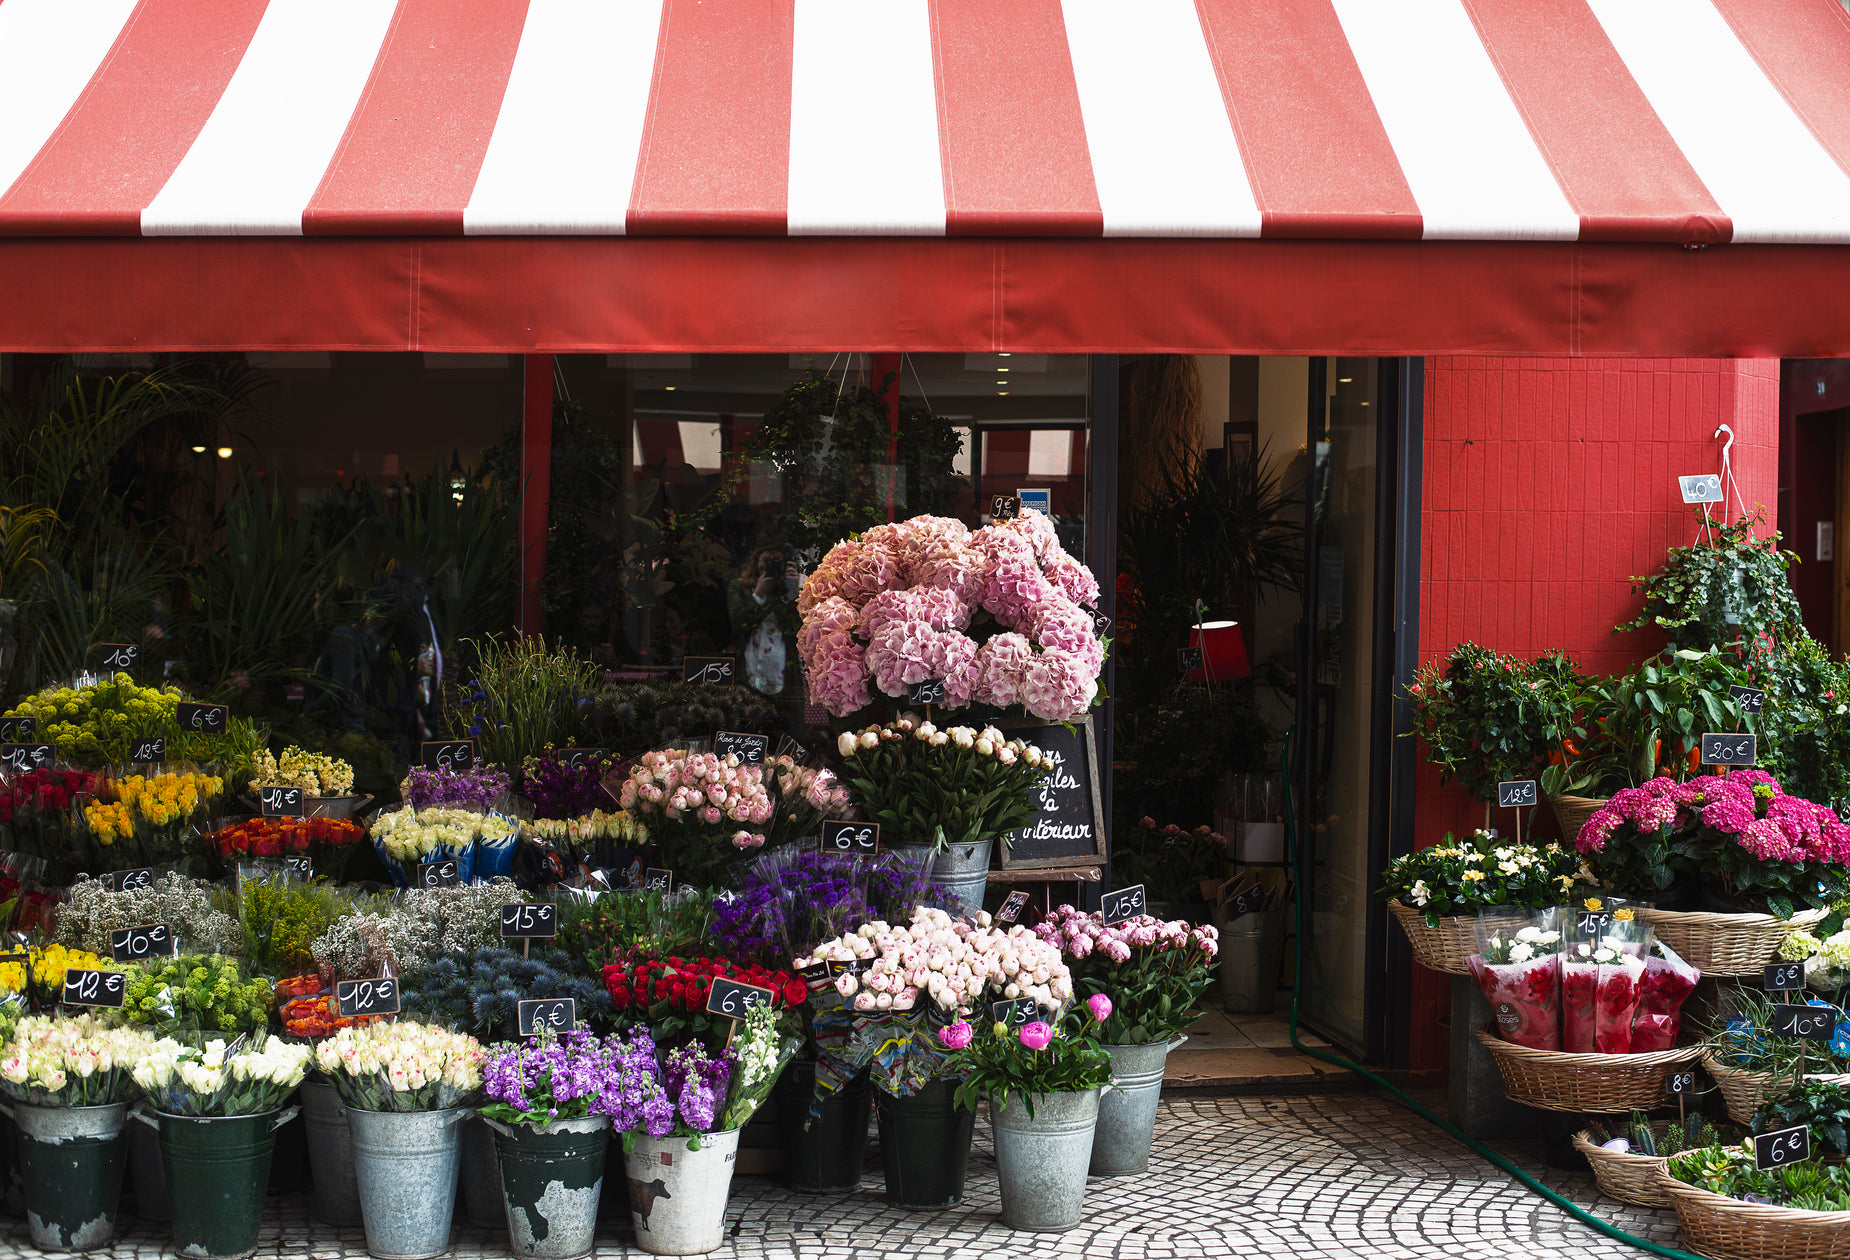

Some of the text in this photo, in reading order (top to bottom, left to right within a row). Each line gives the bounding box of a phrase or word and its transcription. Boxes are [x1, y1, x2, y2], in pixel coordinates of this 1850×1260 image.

[1687, 476, 1717, 498] 40€
[104, 645, 137, 667] 10€
[688, 661, 732, 683] 15€
[911, 680, 944, 703] 15€
[191, 707, 222, 728] 6€
[2, 745, 49, 769] 12€
[134, 738, 165, 761] 12€
[436, 744, 469, 767] 6€
[1709, 740, 1750, 760] 20€
[262, 787, 299, 812] 12€
[1042, 789, 1060, 811] à
[1503, 784, 1533, 803] 12€
[835, 826, 875, 850] 6€
[122, 870, 151, 892] 6€
[426, 862, 456, 886] 6€
[1108, 890, 1143, 919] 15€
[503, 904, 552, 932] 15€
[1577, 912, 1609, 934] 15€
[115, 925, 166, 954] 10€
[65, 970, 122, 1000] 12€
[1775, 965, 1799, 986] 8€
[340, 980, 393, 1011] 12€
[720, 989, 759, 1013] 6€
[532, 1002, 568, 1029] 6€
[1782, 1012, 1829, 1035] 10€
[1672, 1073, 1691, 1093] 8€
[1770, 1131, 1802, 1162] 6€
